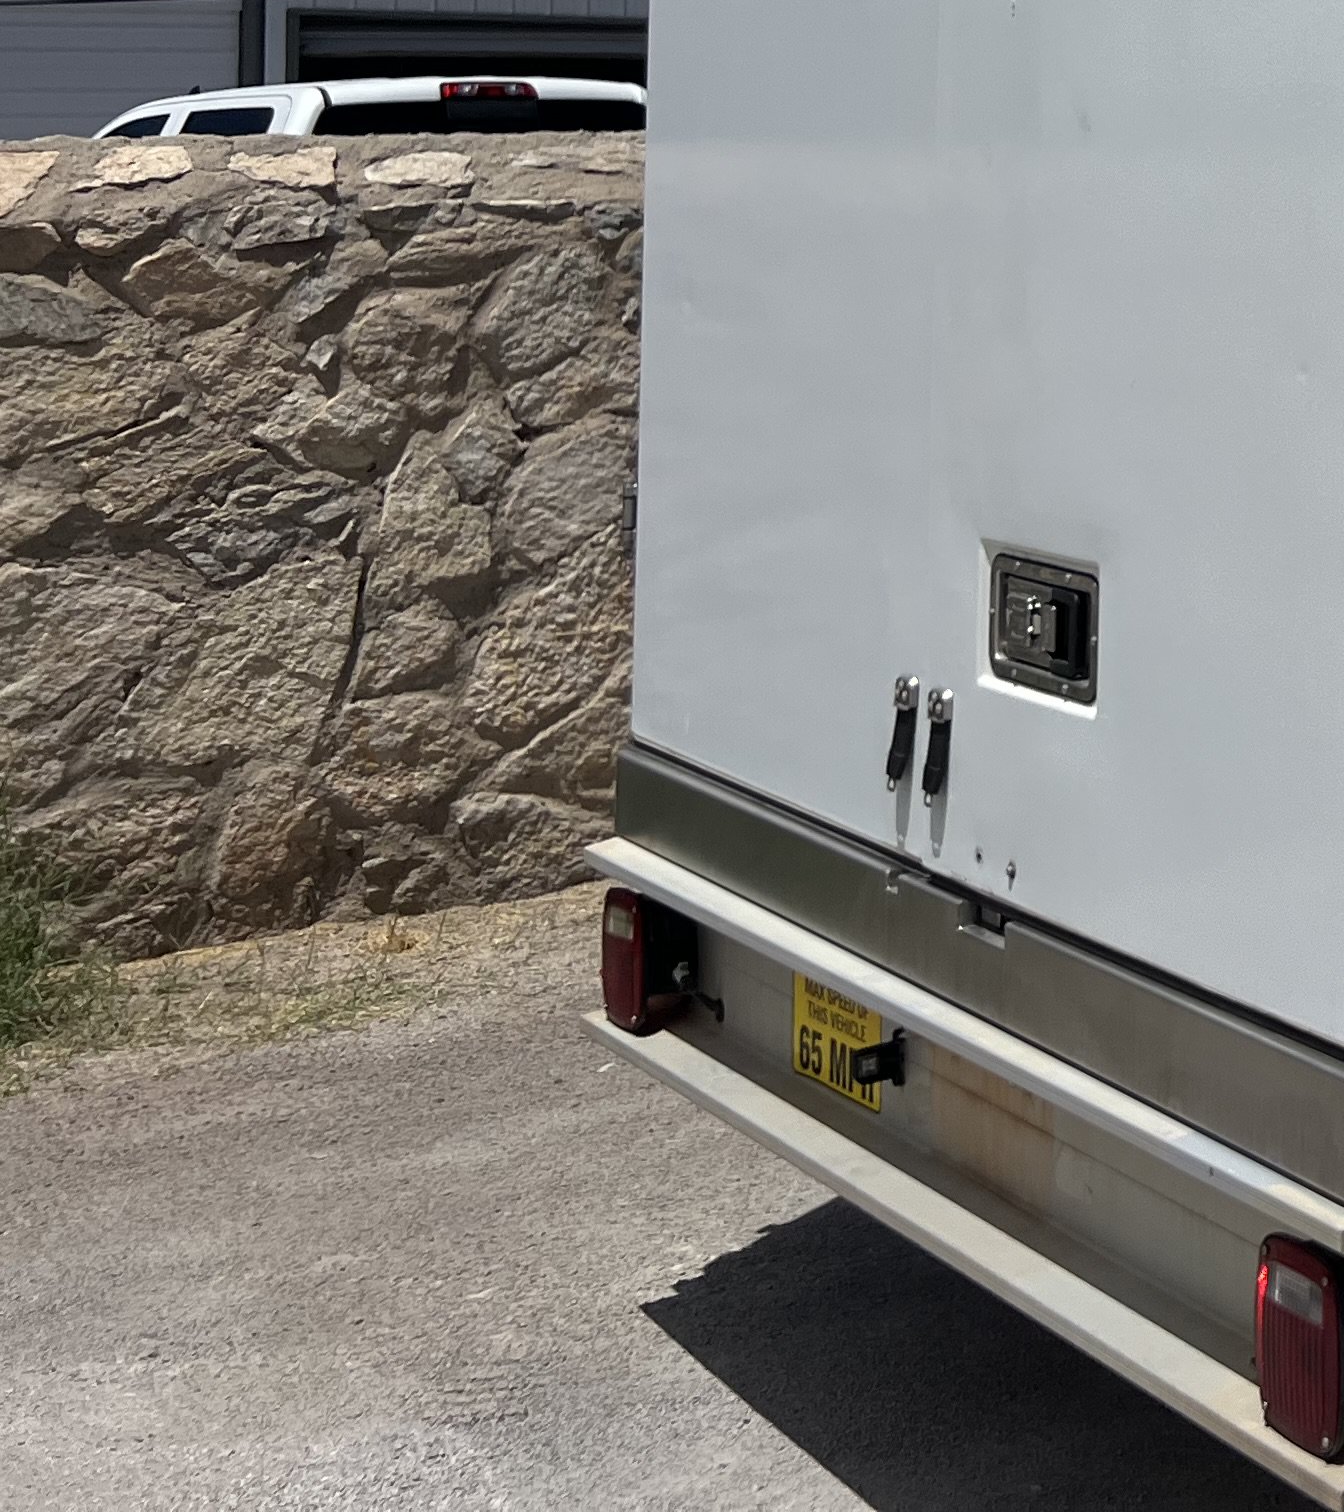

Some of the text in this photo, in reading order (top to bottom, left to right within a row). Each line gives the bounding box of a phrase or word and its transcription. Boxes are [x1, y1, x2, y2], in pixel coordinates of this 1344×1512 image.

[805, 976, 826, 999] MAX
[827, 987, 856, 1014] SPEED
[807, 999, 867, 1043] THIS VEHICLE
[799, 1024, 874, 1103] 65 MP
